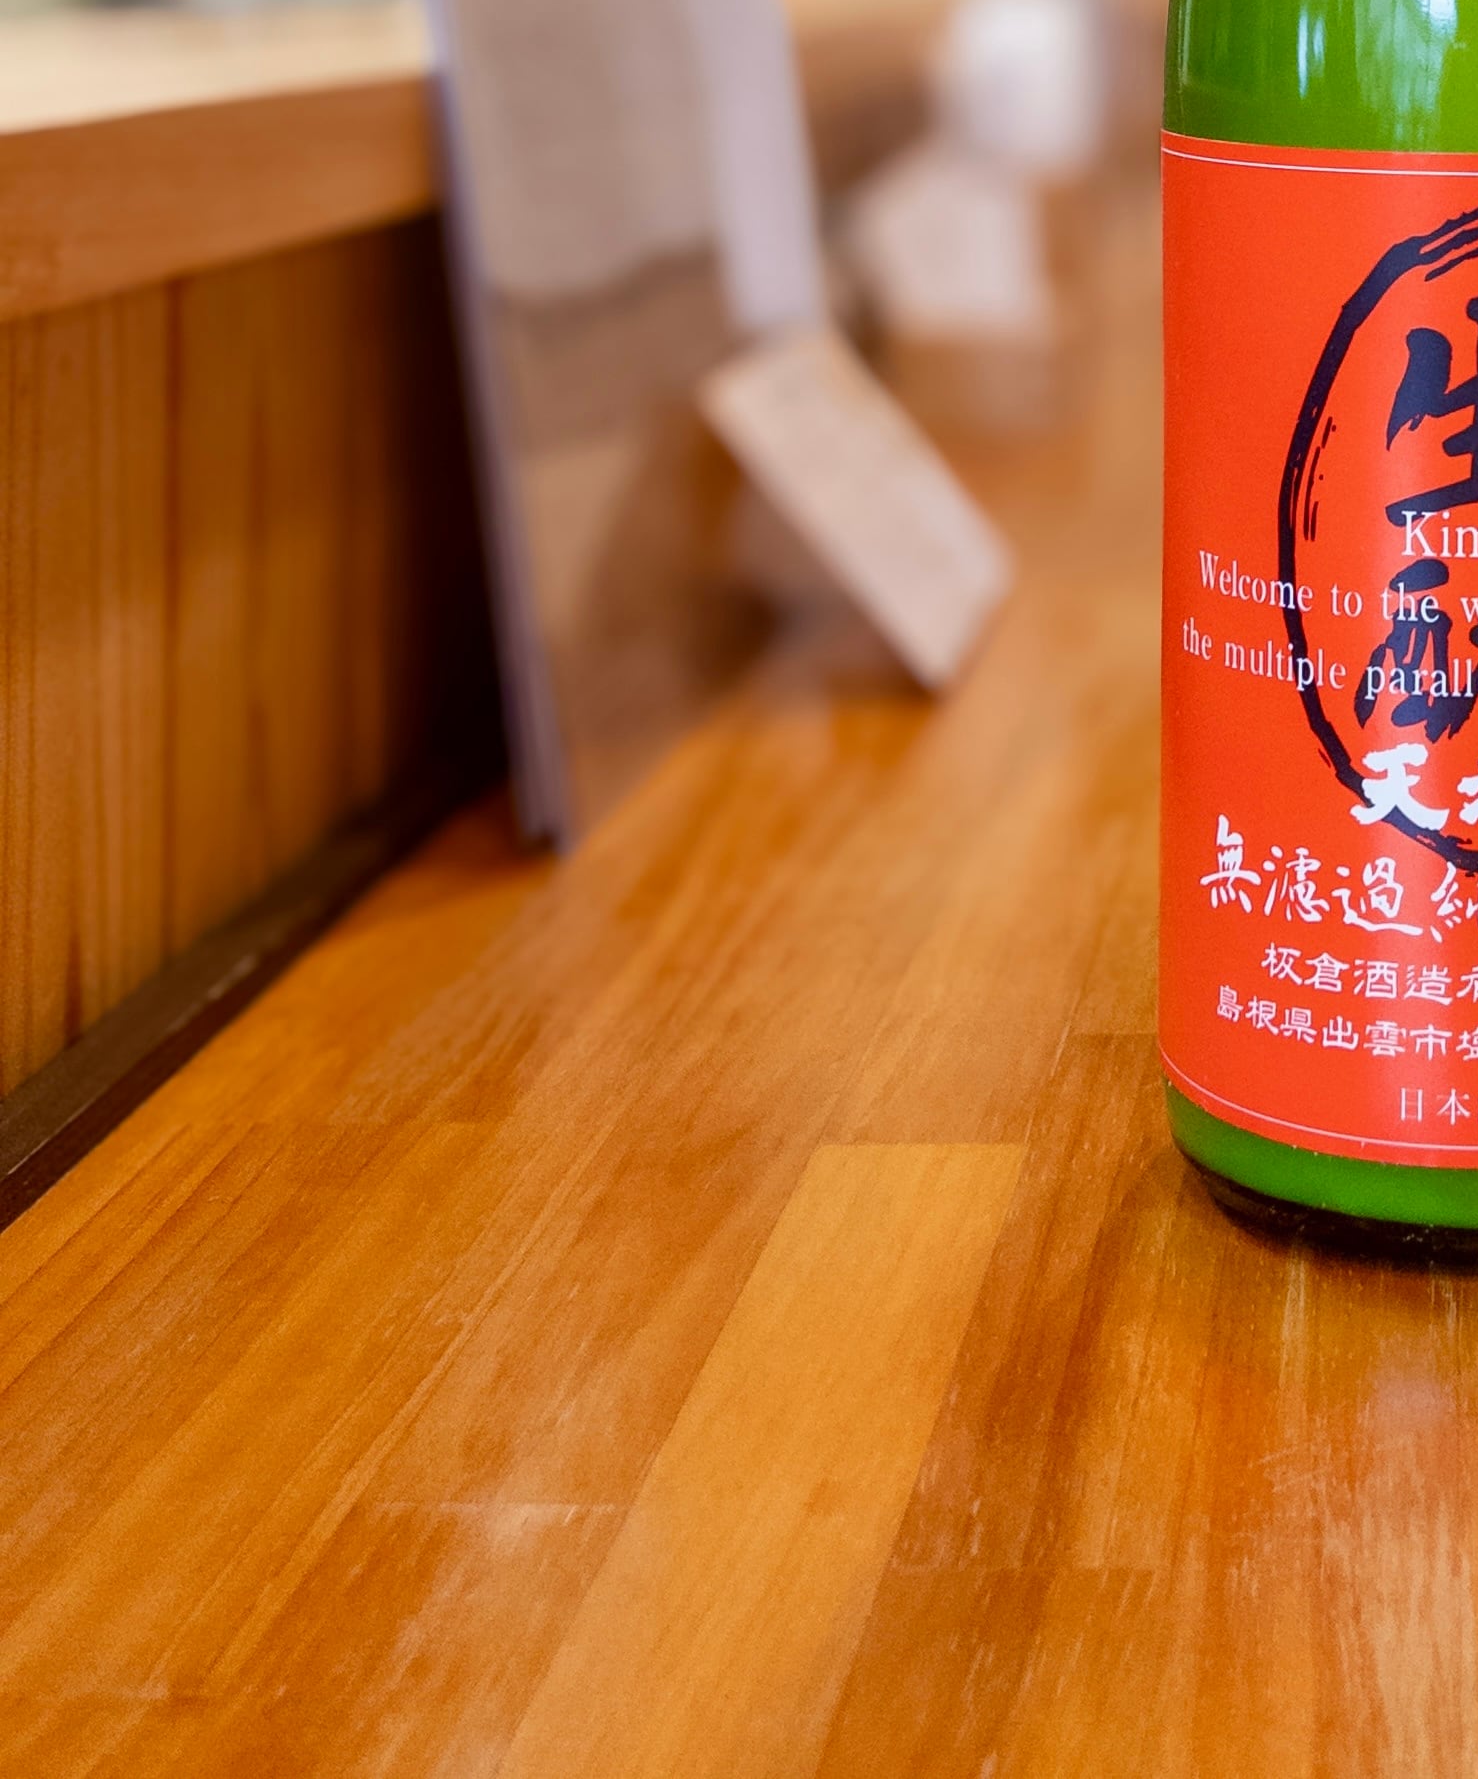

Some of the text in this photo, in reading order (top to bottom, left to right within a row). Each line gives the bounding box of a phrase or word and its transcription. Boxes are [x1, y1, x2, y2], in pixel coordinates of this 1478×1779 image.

[1199, 550, 1314, 612] Welcome
[1330, 583, 1363, 618] to
[1380, 581, 1441, 624] the
[1183, 617, 1213, 661] the
[1224, 637, 1347, 692] multiple
